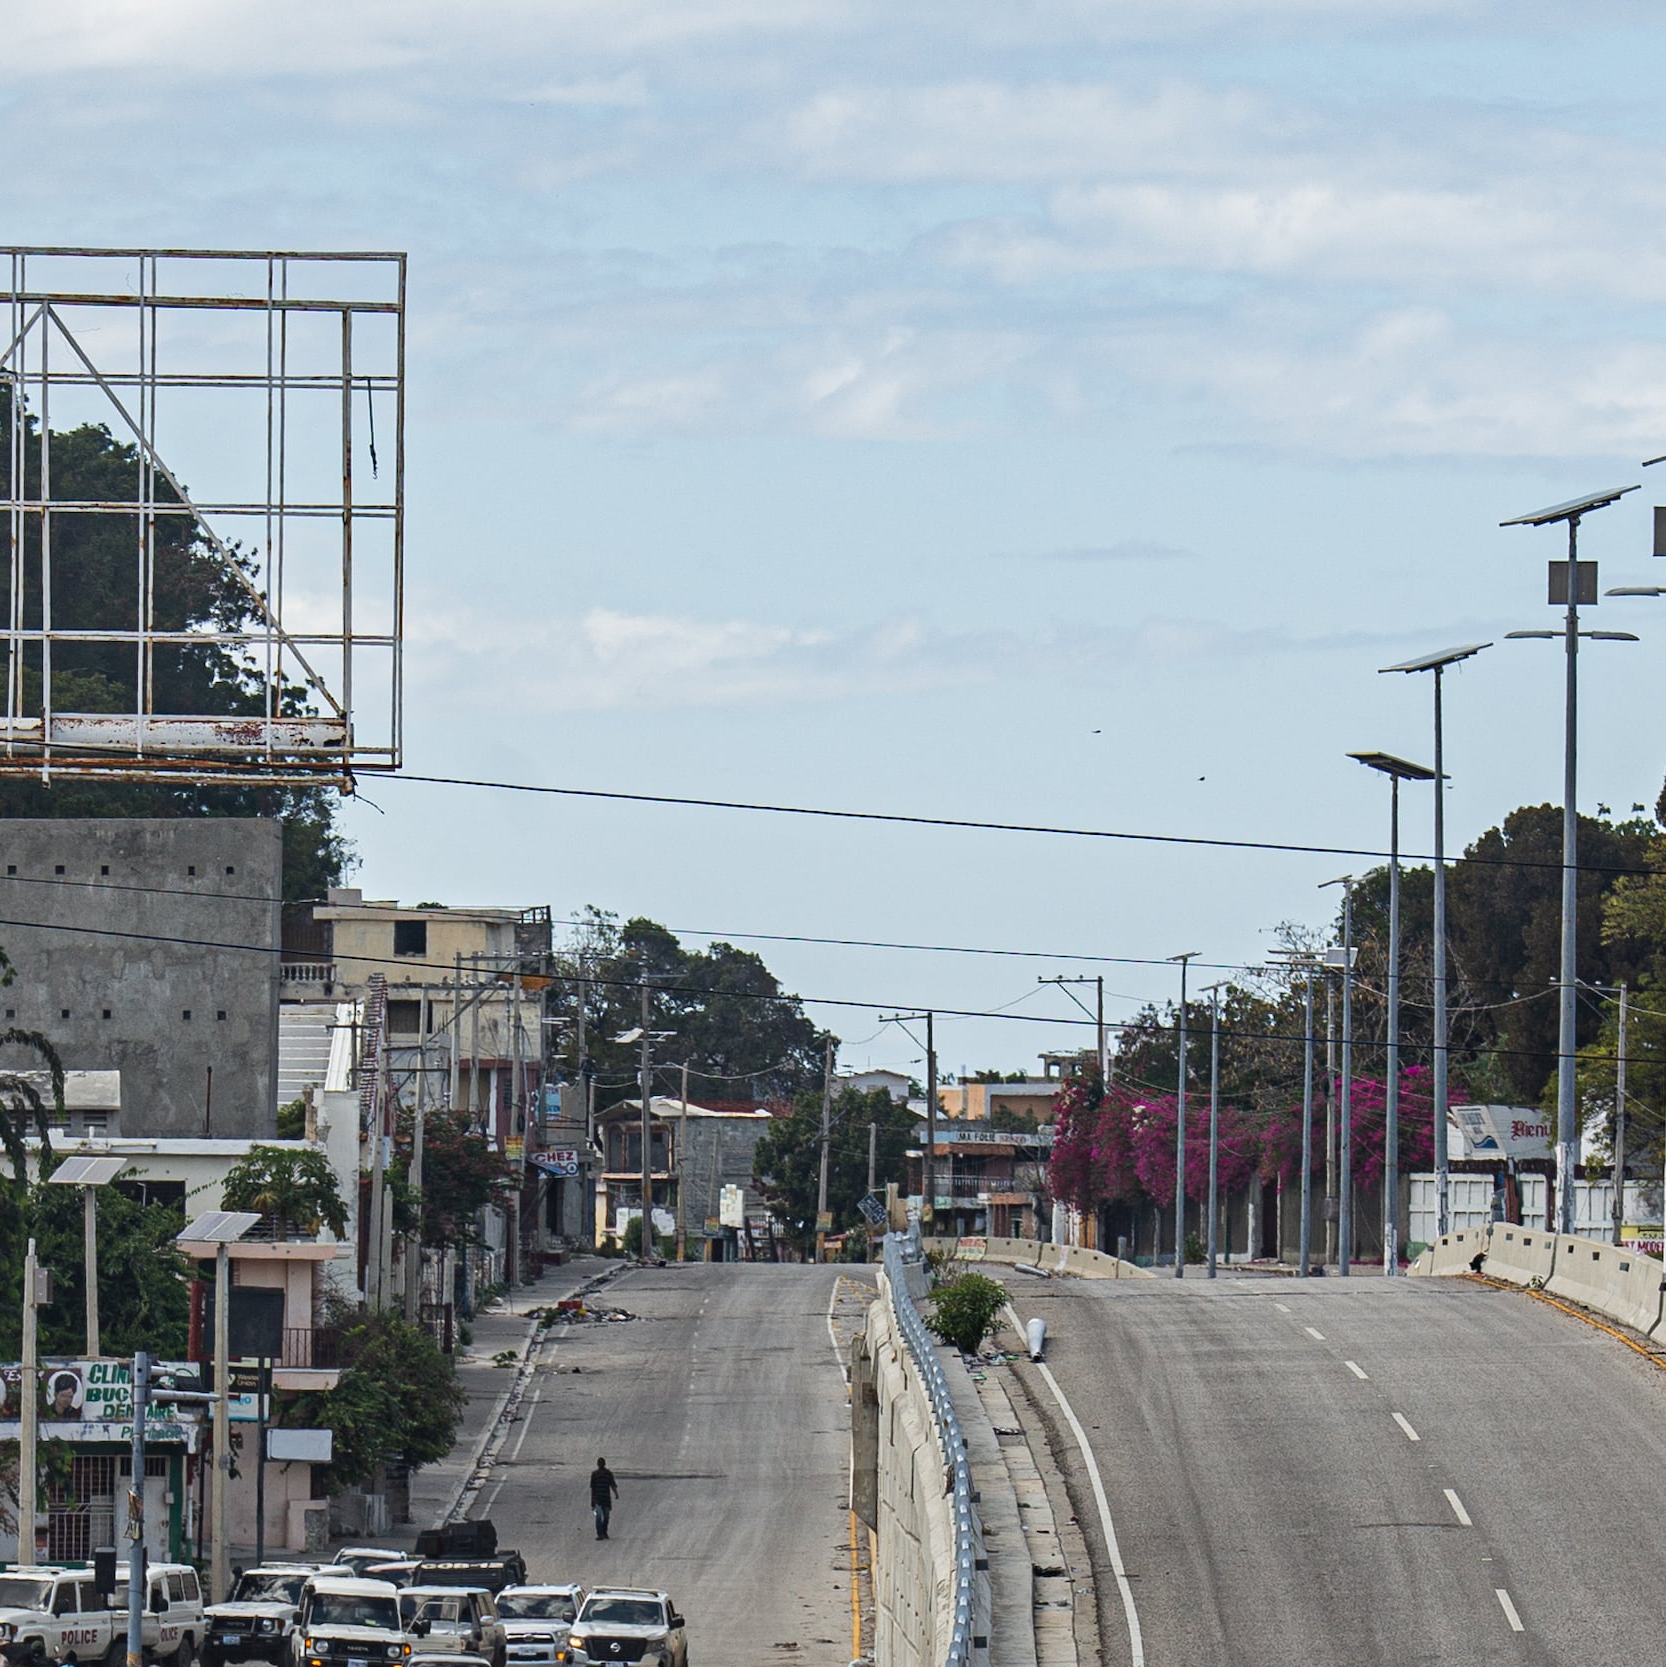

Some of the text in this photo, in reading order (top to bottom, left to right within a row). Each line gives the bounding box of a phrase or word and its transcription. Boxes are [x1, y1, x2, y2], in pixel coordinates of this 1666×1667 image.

[534, 1151, 574, 1162] CHEZ
[102, 1404, 175, 1418] DENAIRE
[61, 1628, 98, 1645] POLICE
[160, 1626, 179, 1643] OLICE
